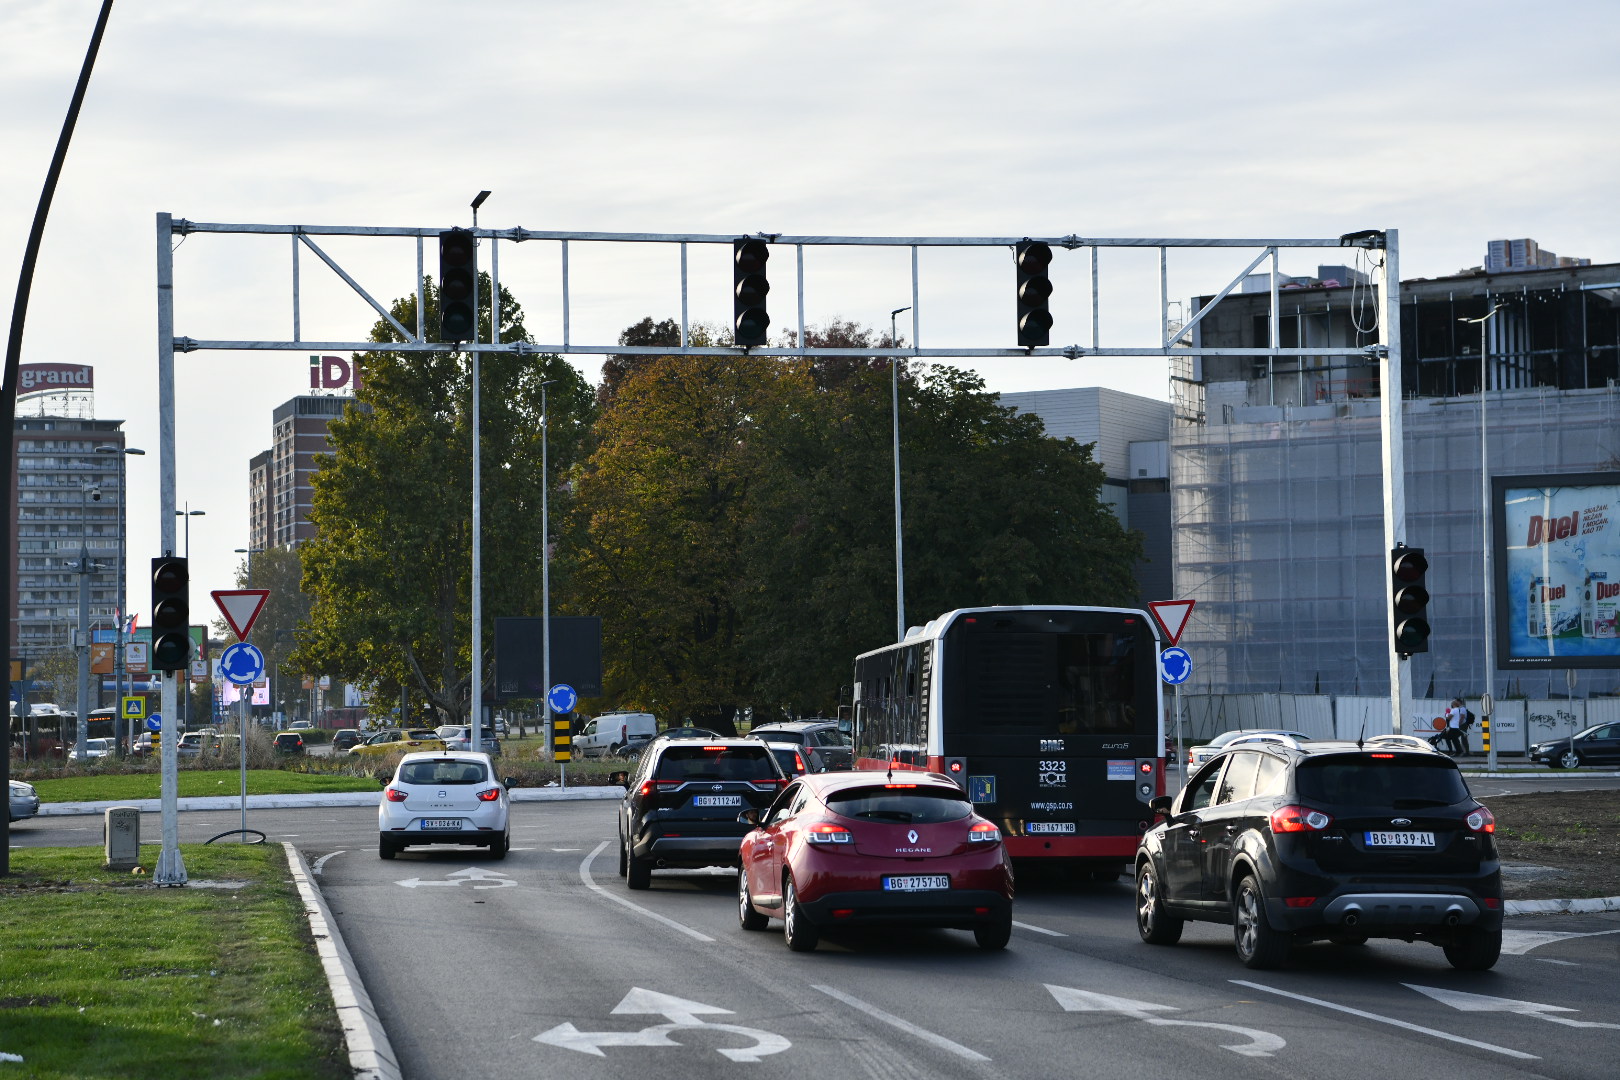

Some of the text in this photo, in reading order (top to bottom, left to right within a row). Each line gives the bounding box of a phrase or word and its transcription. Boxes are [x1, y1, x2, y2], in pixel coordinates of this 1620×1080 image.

[21, 367, 90, 388] grand
[1526, 511, 1580, 548] Duel
[1597, 581, 1620, 601] Due
[1039, 739, 1065, 752] BMC
[1039, 760, 1066, 772] 3323
[1030, 802, 1073, 811] www.gsp.co.rs
[1372, 833, 1387, 844] BG
[890, 878, 903, 889] BG
